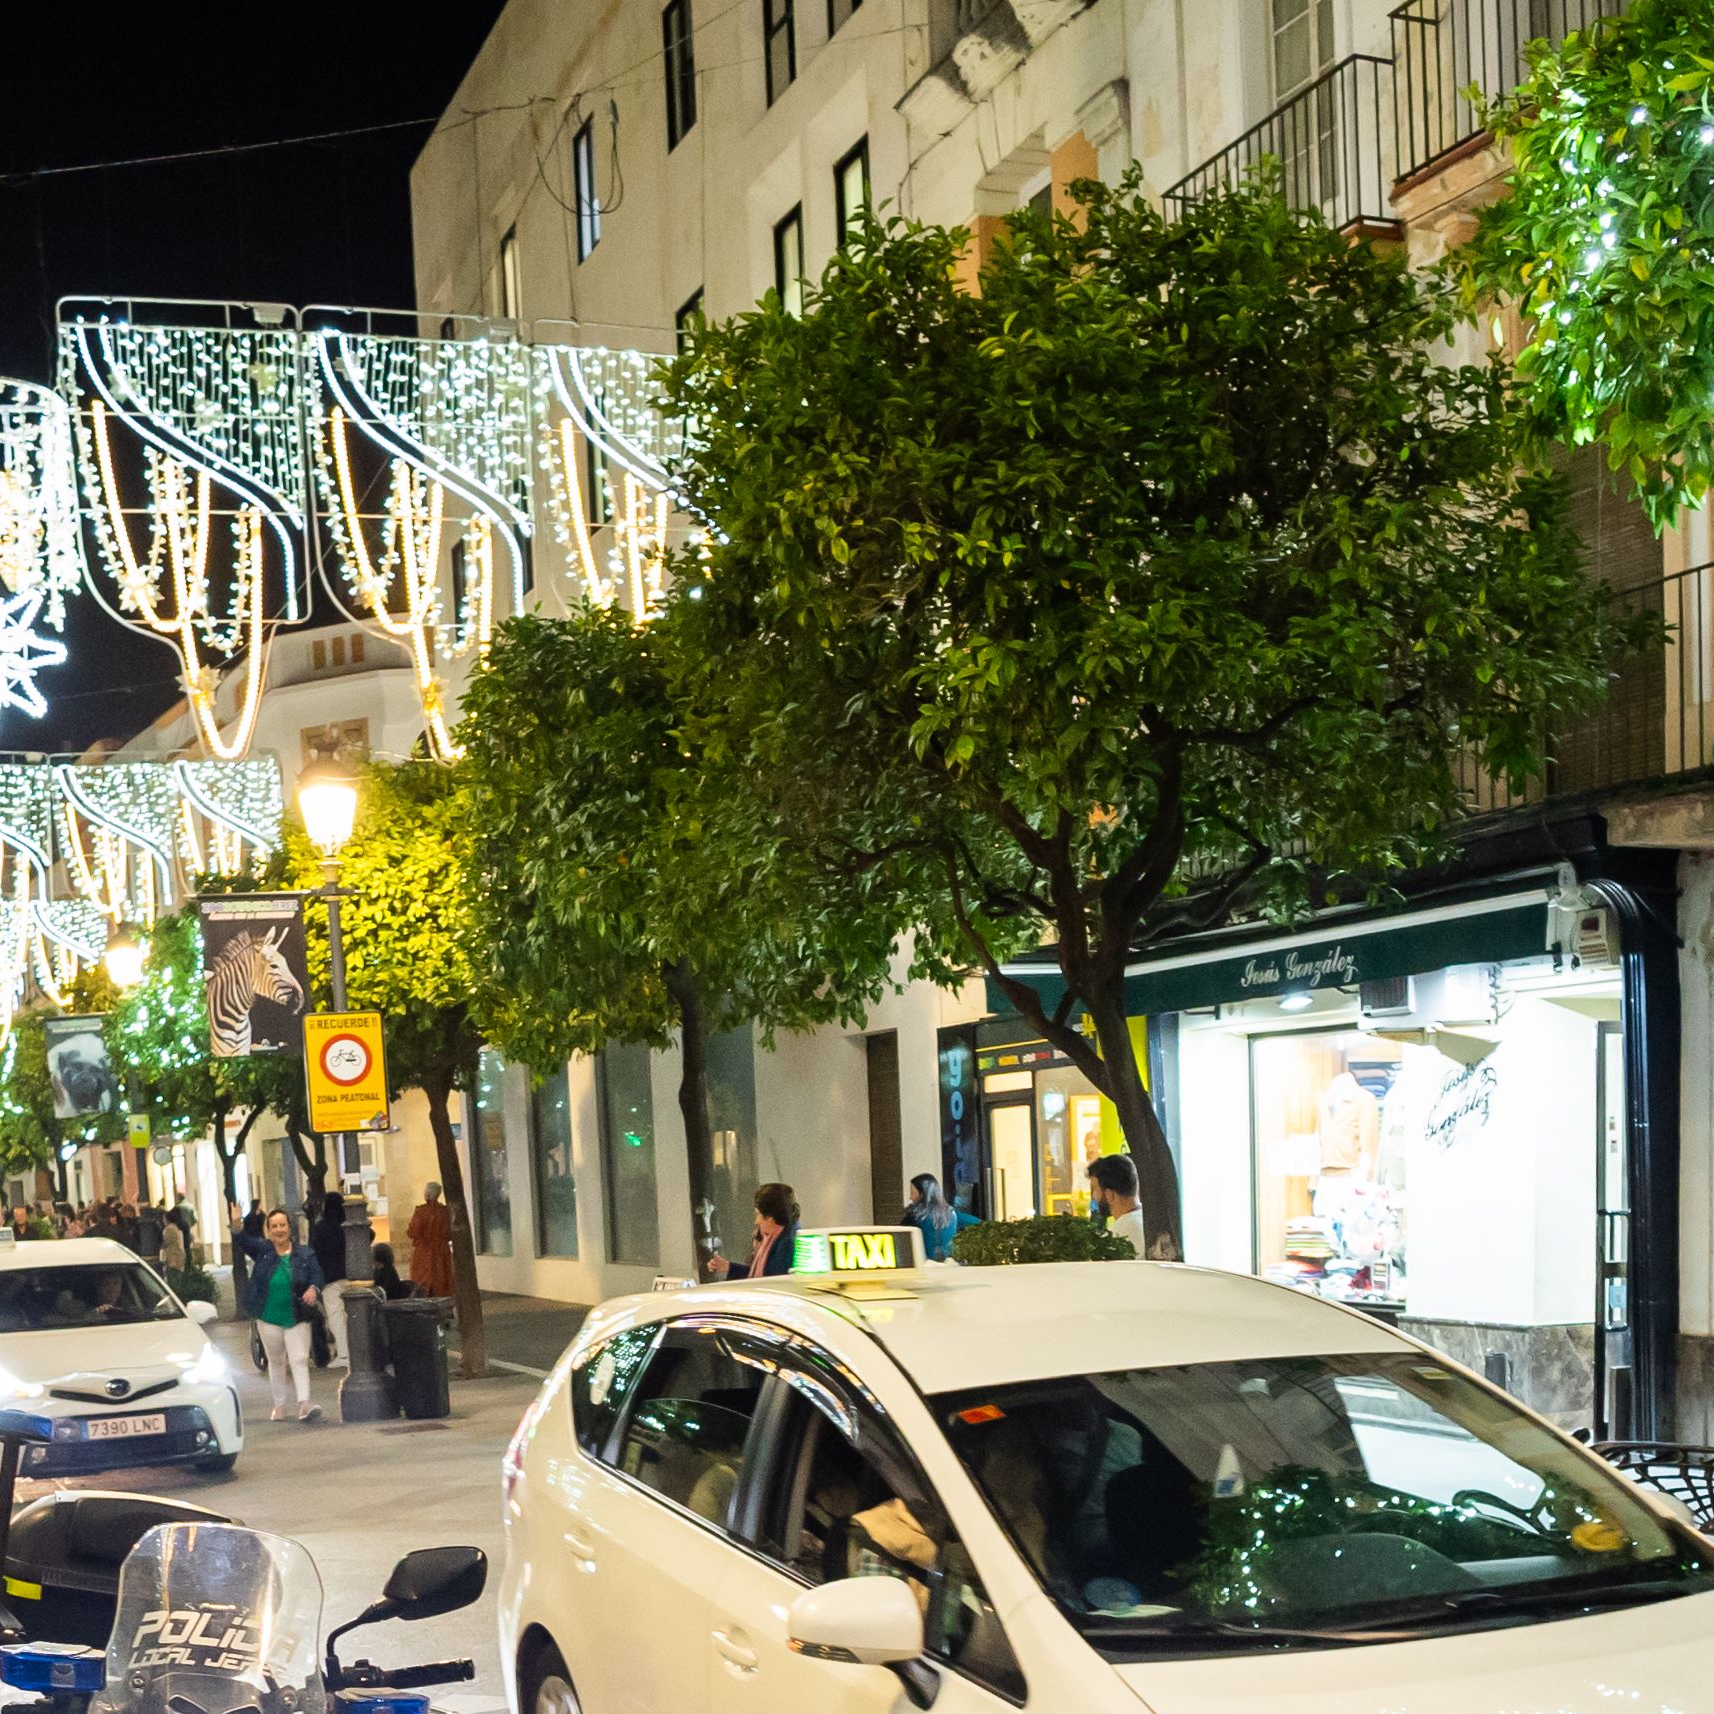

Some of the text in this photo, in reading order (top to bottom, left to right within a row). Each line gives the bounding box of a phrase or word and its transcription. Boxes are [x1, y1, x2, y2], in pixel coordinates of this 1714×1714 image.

[1285, 945, 1359, 987] González
[317, 1017, 370, 1029] RECUERDE
[317, 1092, 381, 1104] ZONA PEATONAL
[828, 1233, 897, 1270] TAXI
[90, 1417, 160, 1437] 7390 LNC
[128, 1647, 286, 1678] LOCAL JER
